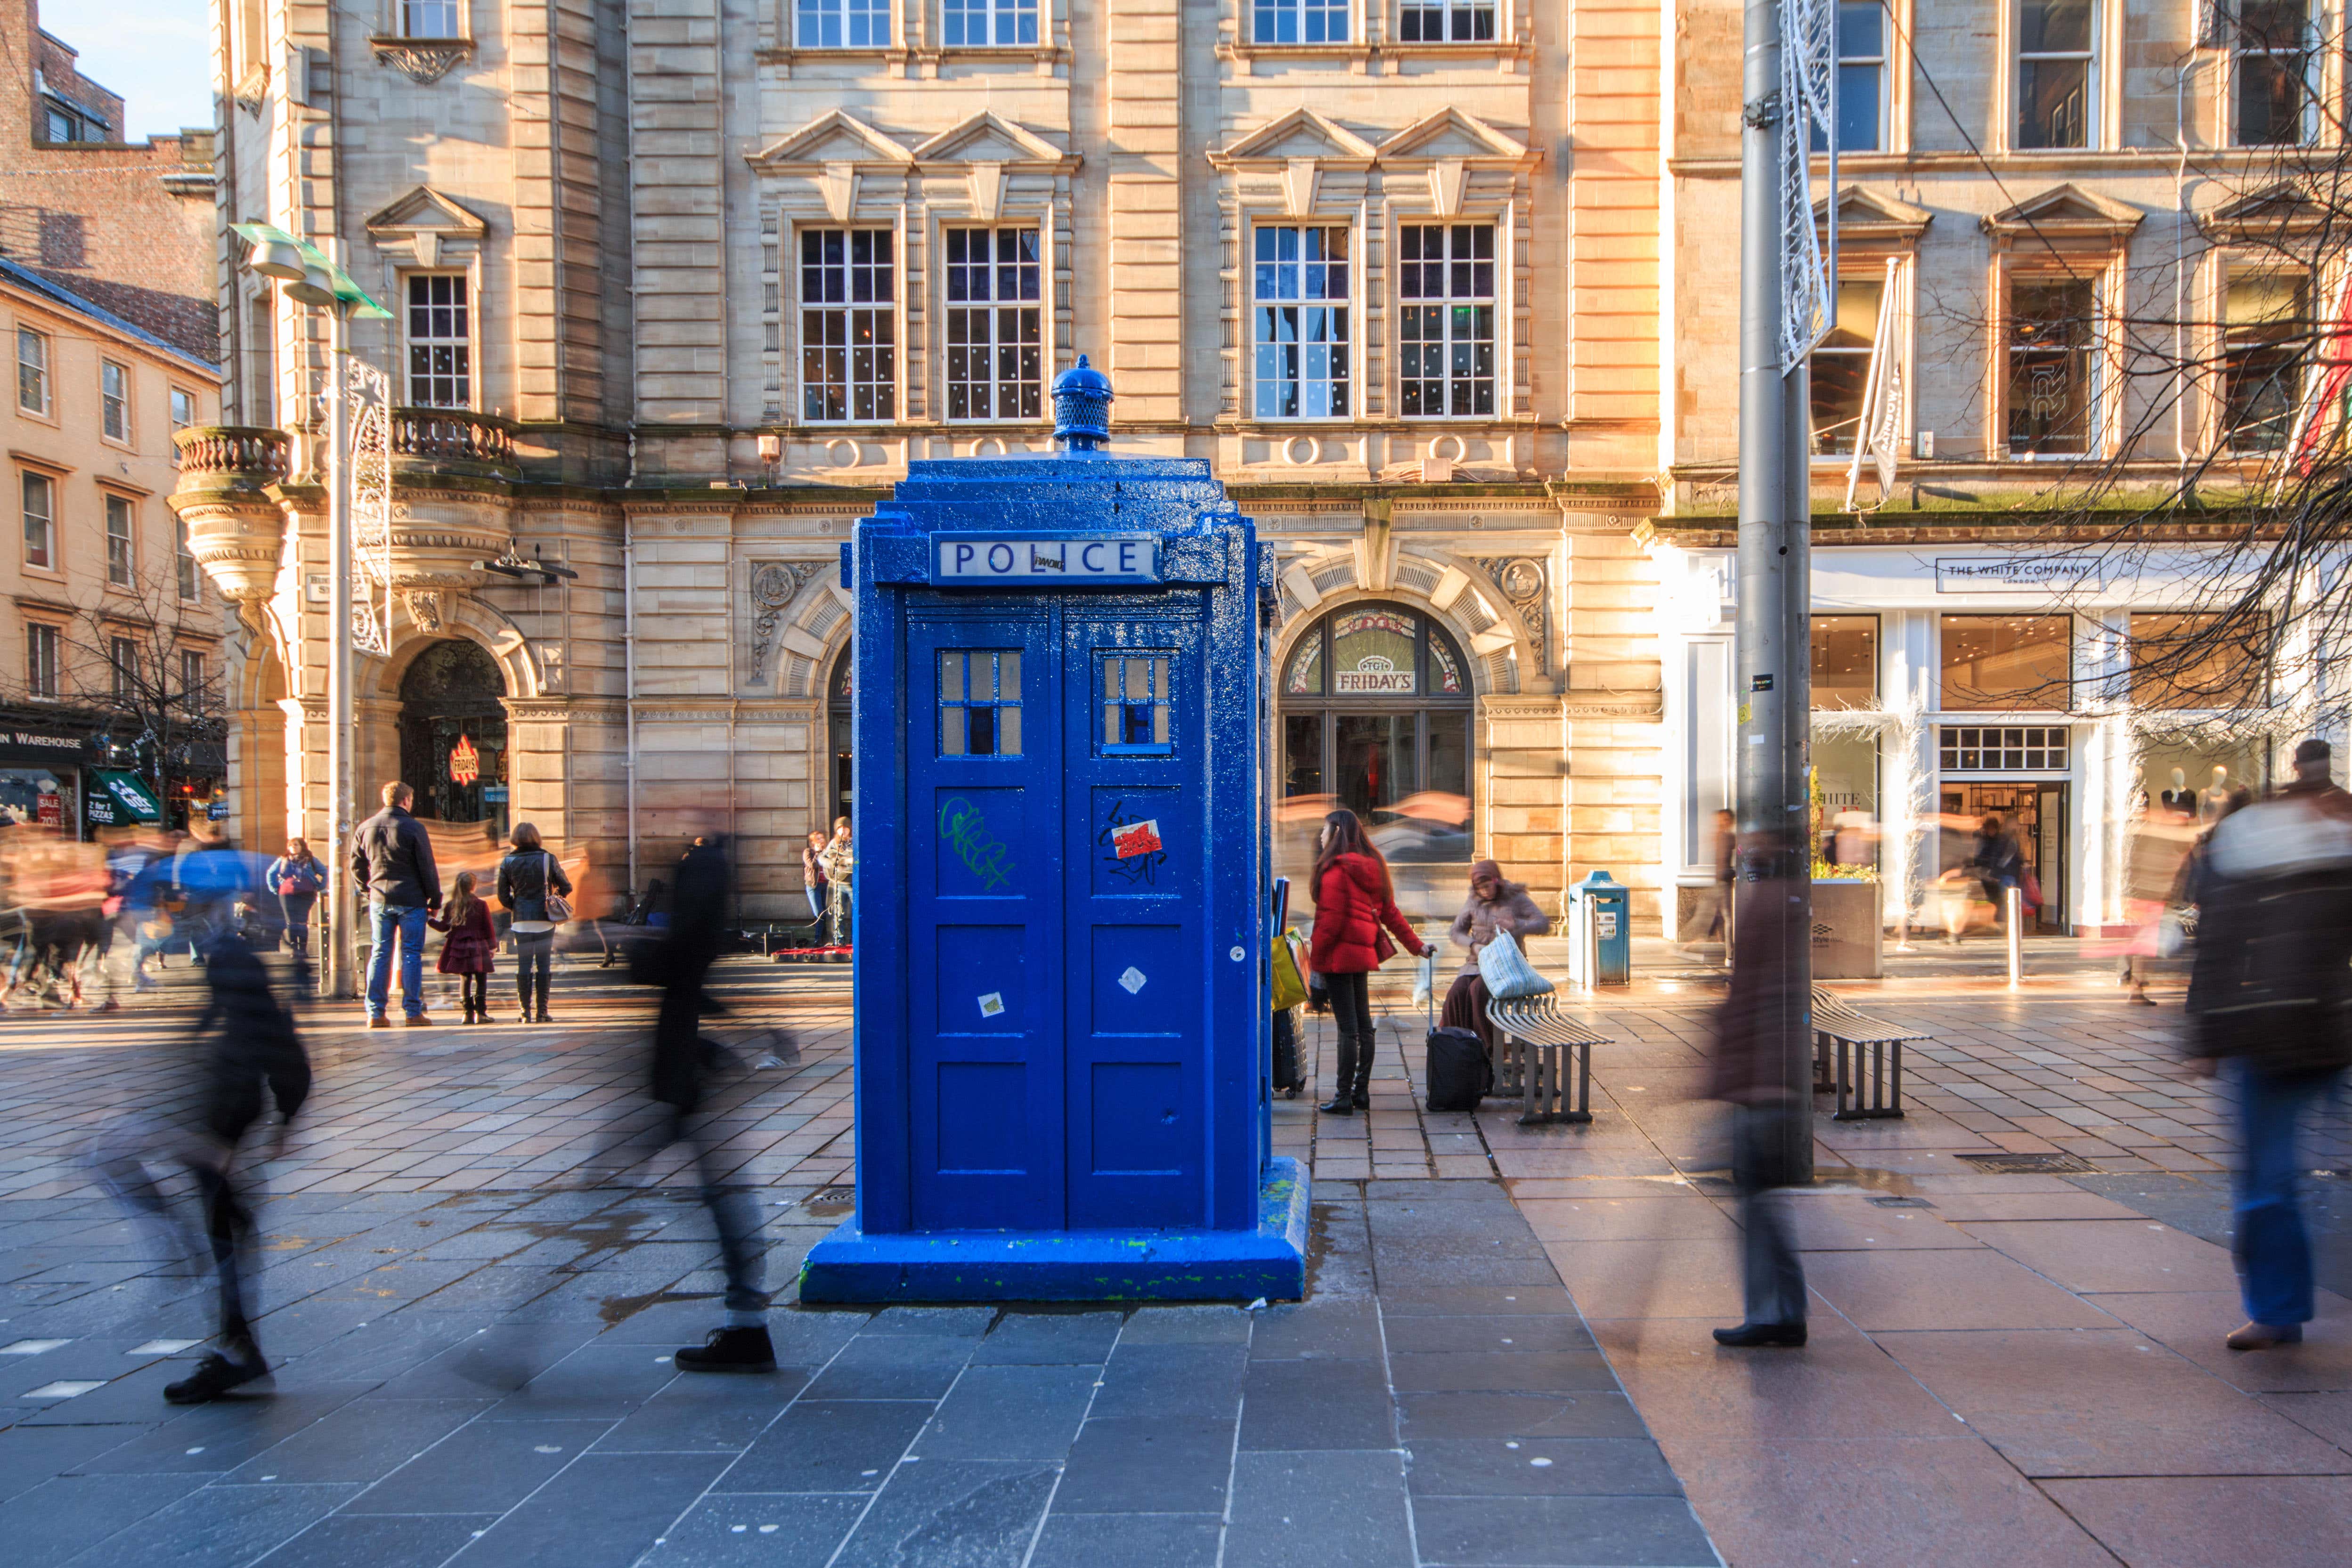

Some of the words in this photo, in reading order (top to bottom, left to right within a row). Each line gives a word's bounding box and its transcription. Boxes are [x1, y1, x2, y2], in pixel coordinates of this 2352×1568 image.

[956, 543, 1136, 573] POLICE
[1949, 566, 1972, 575] THE
[1978, 566, 2018, 575] WHITE
[2024, 565, 2087, 575] COMPANY
[1367, 662, 1384, 670] TGI
[1341, 674, 1411, 689] FRIDAY'S
[16, 732, 82, 748] WAREHOUSE
[40, 799, 59, 807] SALE
[1820, 793, 1860, 804] HITE
[89, 801, 94, 809] 2
[89, 809, 114, 820] PIZZAS
